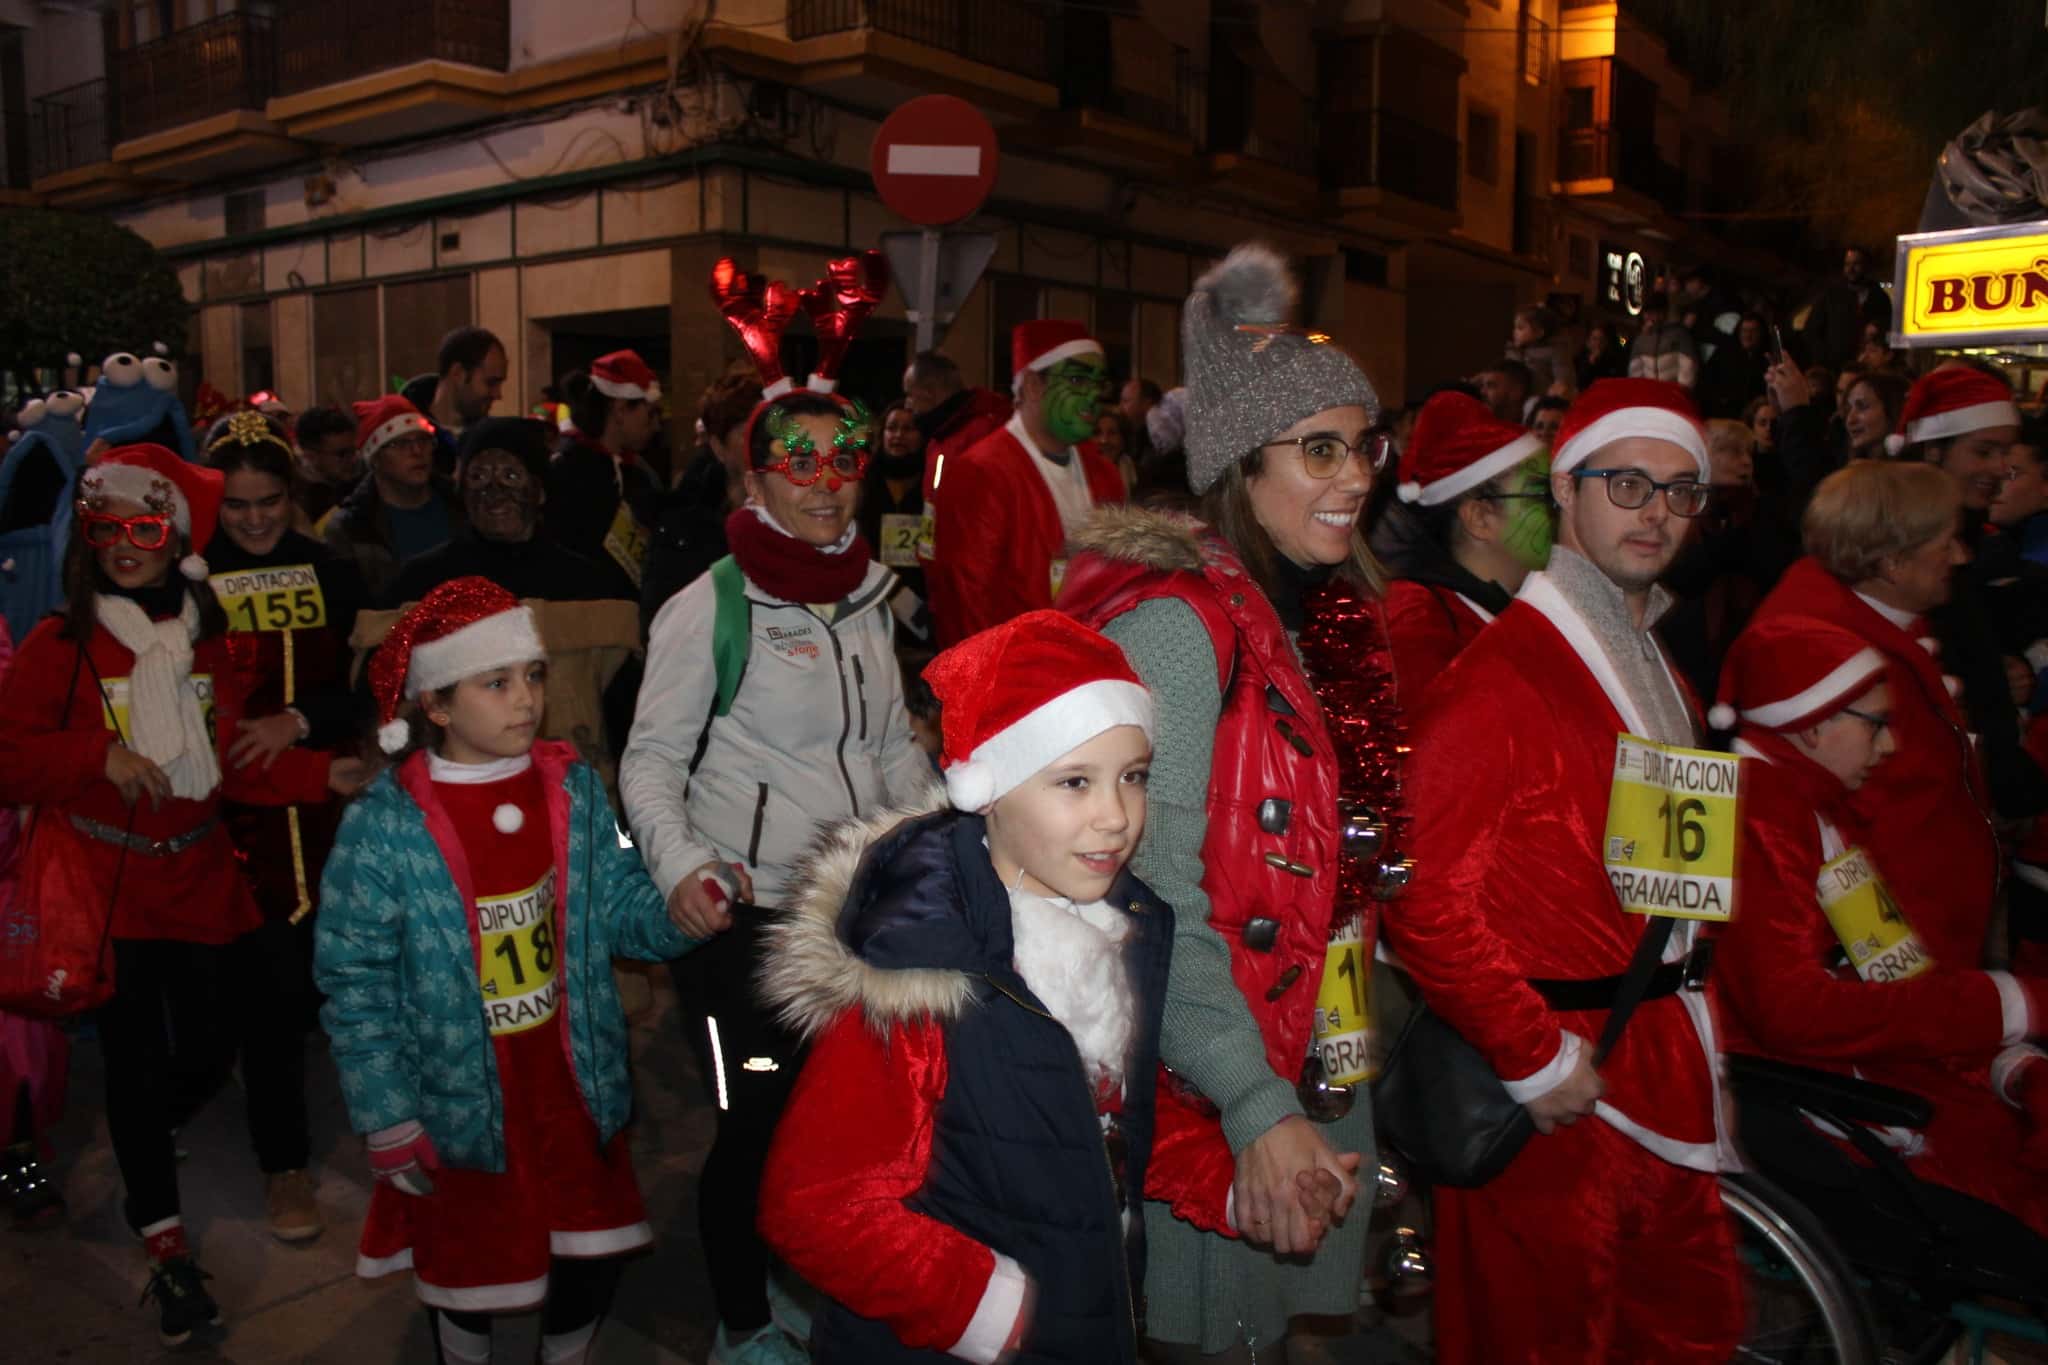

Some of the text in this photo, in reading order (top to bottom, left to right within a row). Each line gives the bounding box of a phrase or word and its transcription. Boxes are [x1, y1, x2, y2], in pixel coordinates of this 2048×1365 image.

[224, 568, 317, 595] DIPUTACION
[237, 589, 320, 632] 155
[1658, 794, 1707, 861] 16
